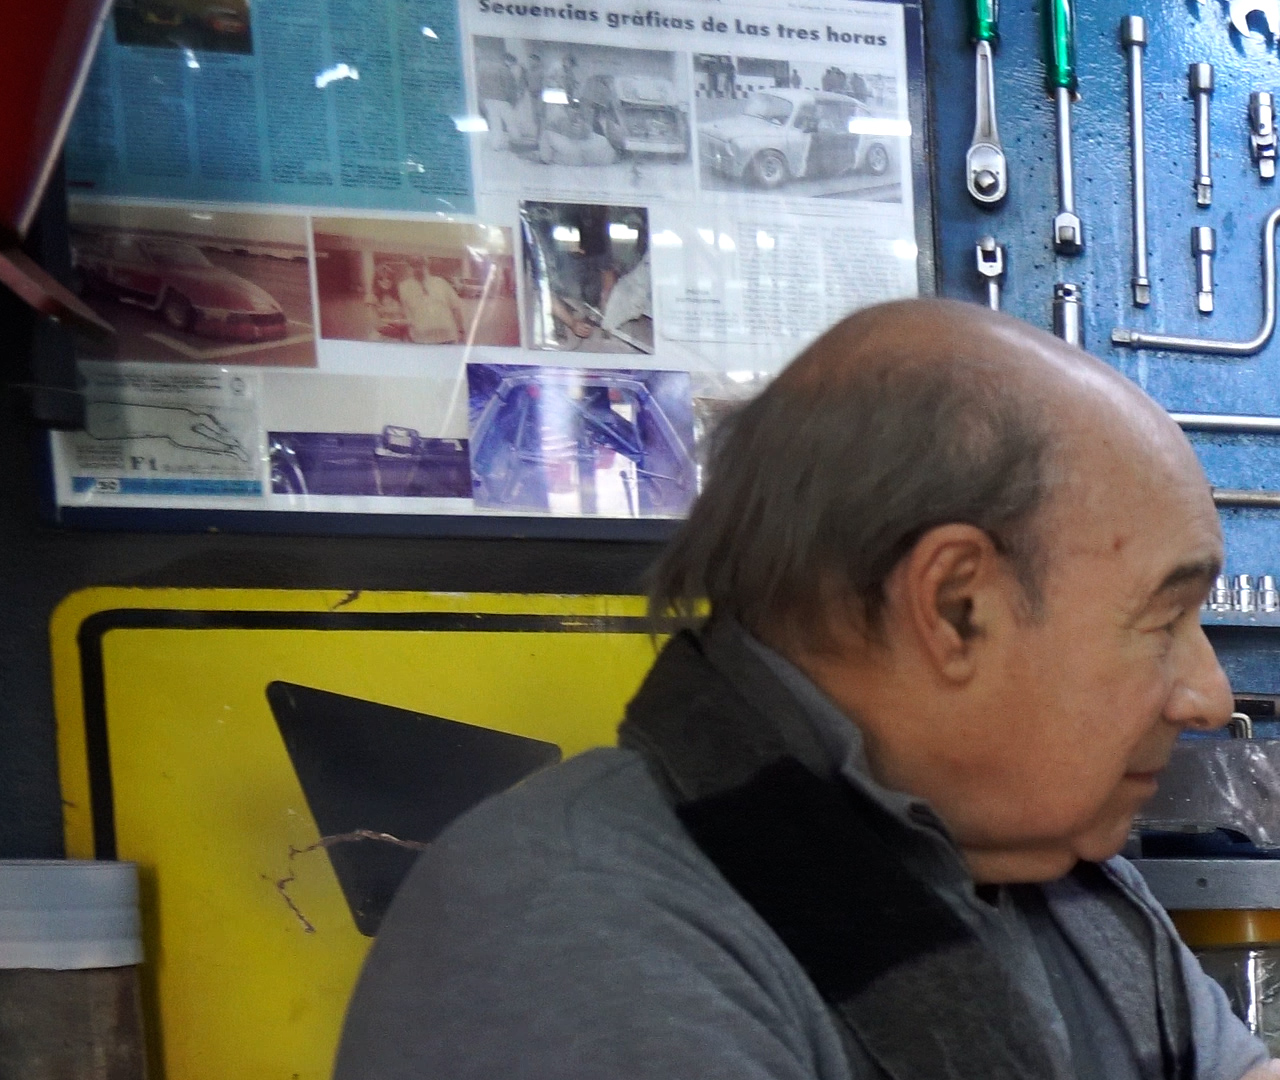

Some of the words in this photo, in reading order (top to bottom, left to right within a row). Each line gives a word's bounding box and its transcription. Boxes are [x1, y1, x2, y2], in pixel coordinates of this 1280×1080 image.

[479, 1, 598, 23] Secuencias
[702, 17, 728, 34] de
[735, 19, 770, 38] Las
[777, 25, 820, 41] tres
[827, 26, 888, 46] horas
